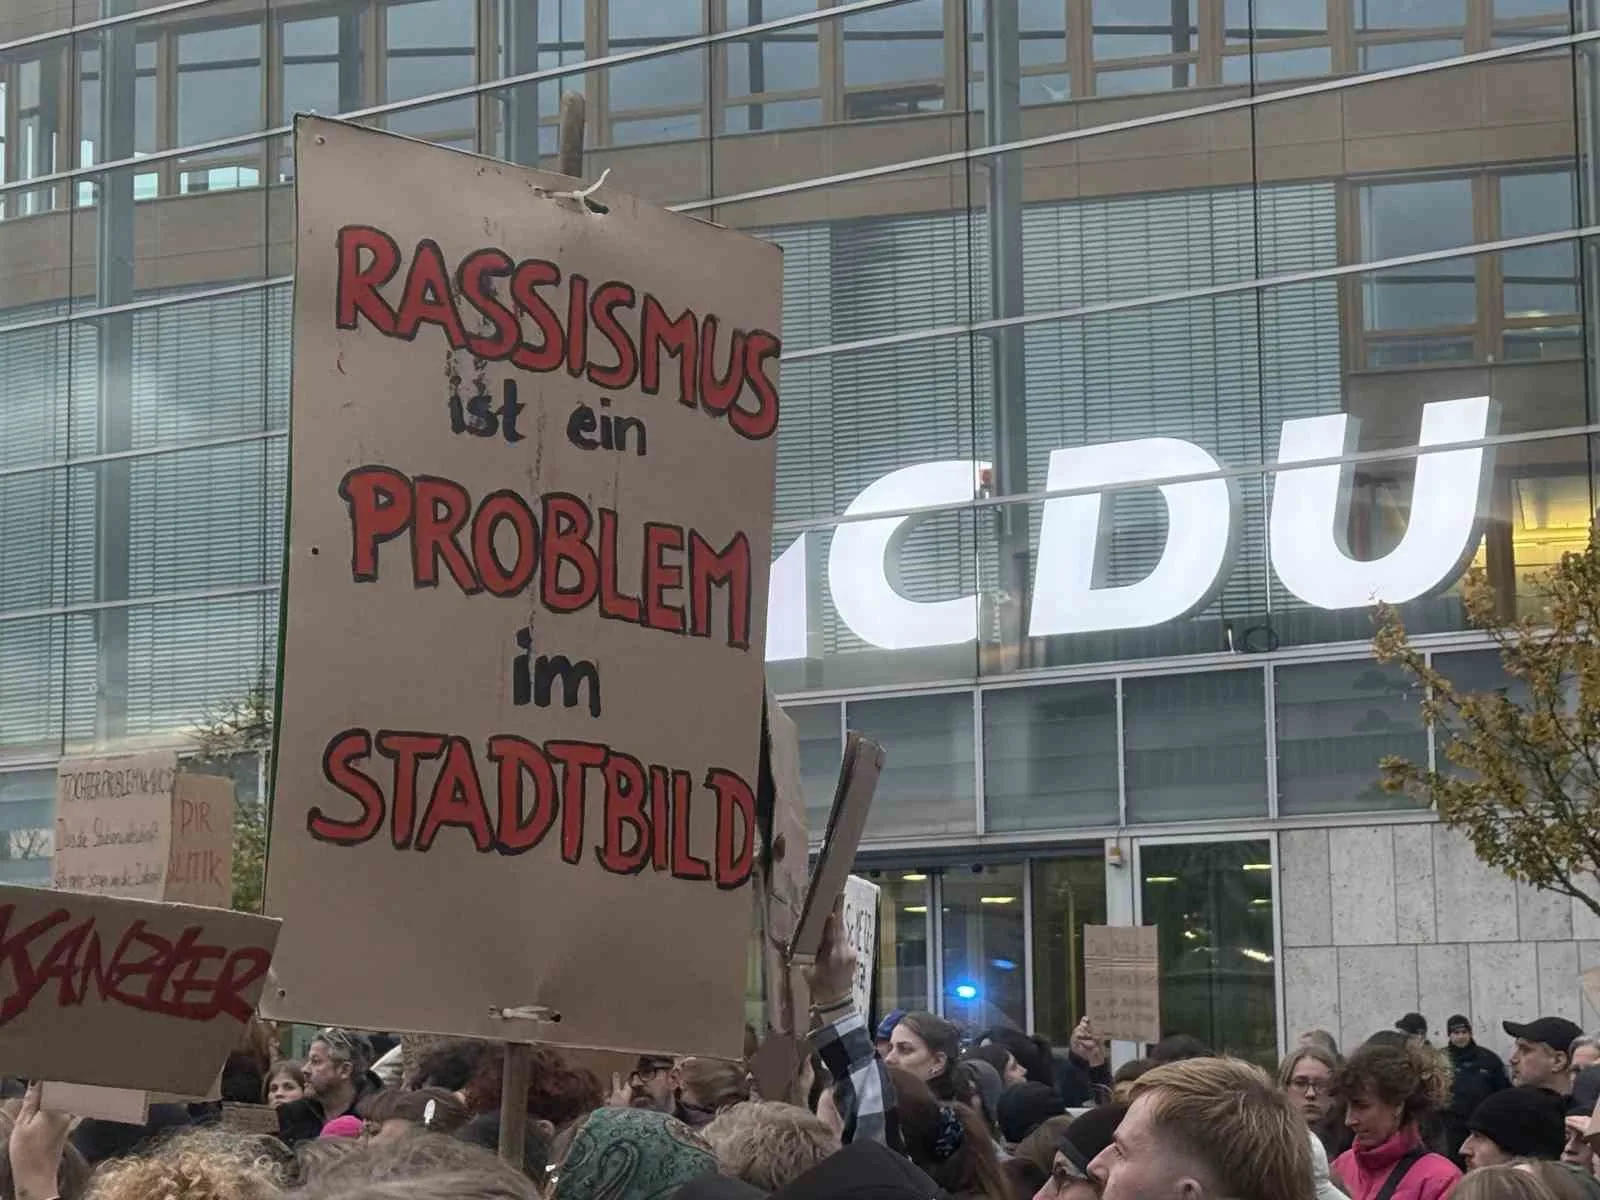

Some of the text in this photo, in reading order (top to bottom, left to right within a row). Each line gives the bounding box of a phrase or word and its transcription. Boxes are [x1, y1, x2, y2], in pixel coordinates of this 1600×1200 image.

[336, 225, 781, 440] RASSISMUS
[450, 375, 647, 456] ist ein
[338, 465, 752, 651] PROBLEM
[828, 396, 1492, 650] CDU
[513, 627, 601, 717] im
[307, 728, 757, 890] STADTBILD
[0, 903, 272, 1027] KANZLER
